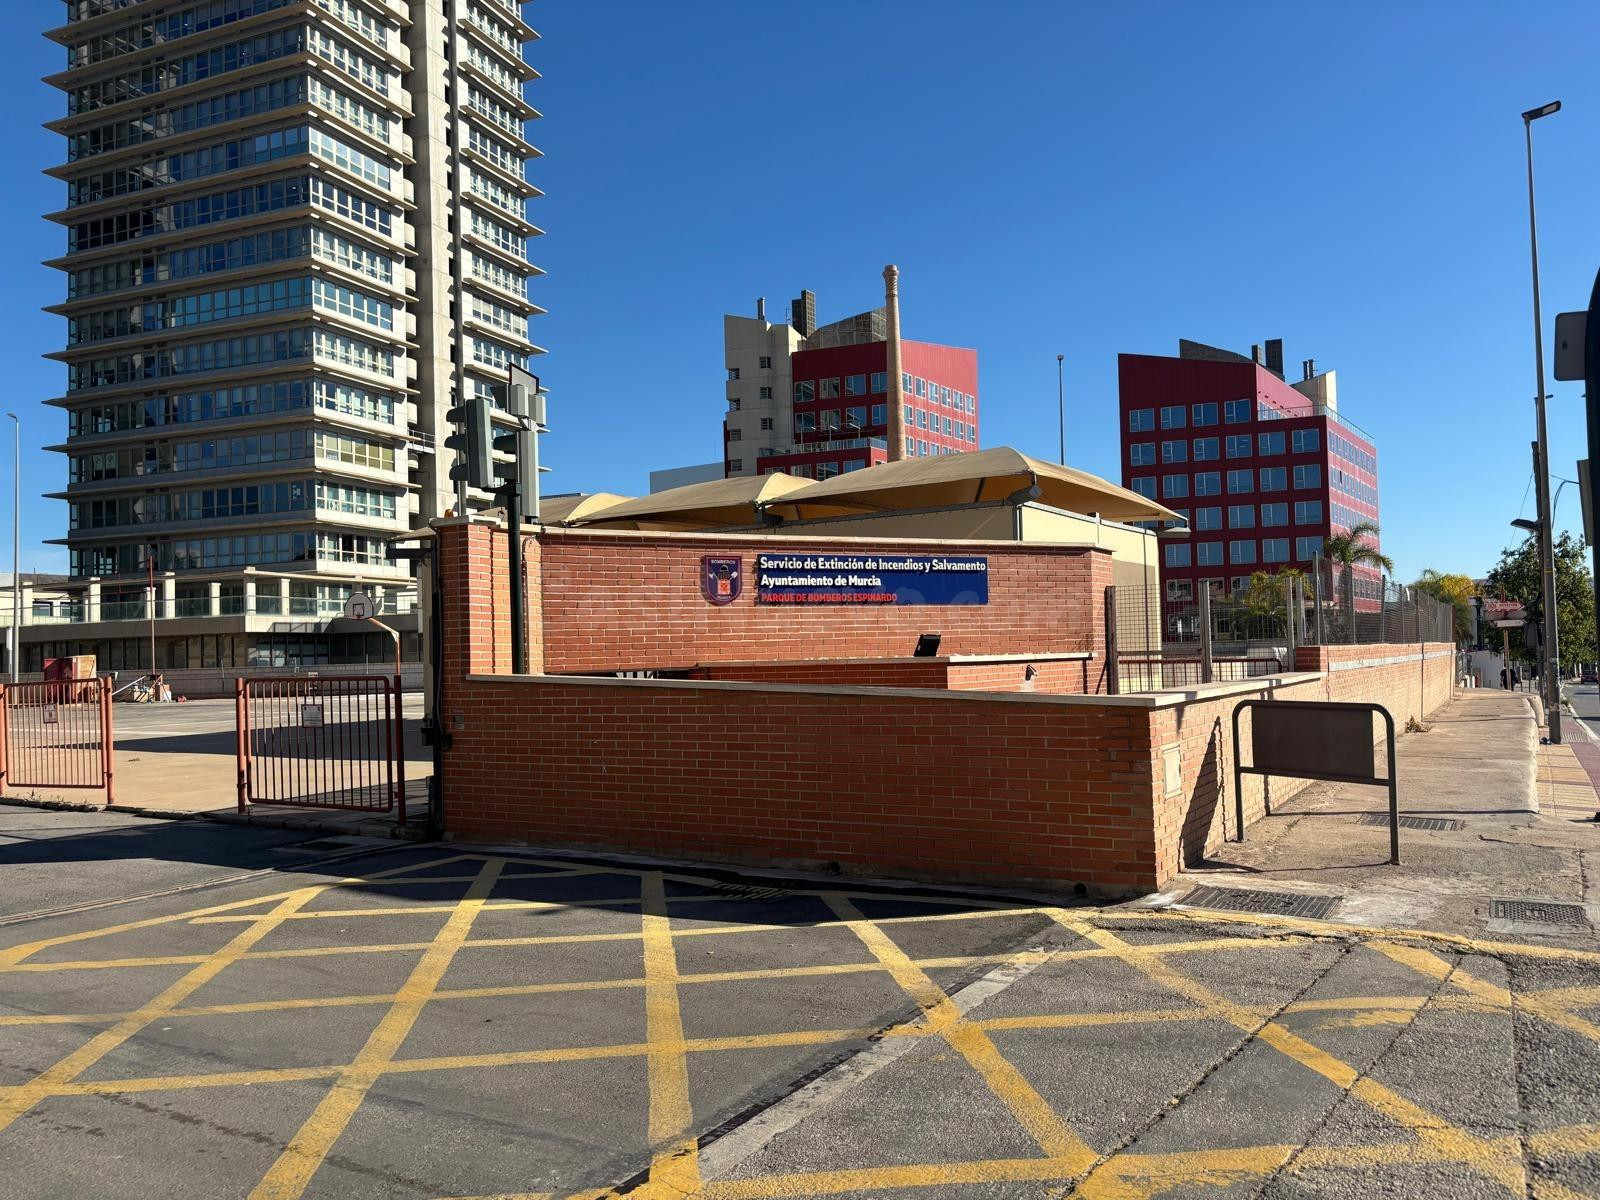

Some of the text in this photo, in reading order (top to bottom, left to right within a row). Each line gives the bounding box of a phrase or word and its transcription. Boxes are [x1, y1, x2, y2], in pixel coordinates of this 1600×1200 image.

[760, 557, 986, 573] Servicio de Extinción de Incendios y Salvamento
[760, 574, 881, 589] Ayuntamiento de Murcia
[761, 593, 898, 602] PARQUE DE BOMBEROS ESPINARDO
